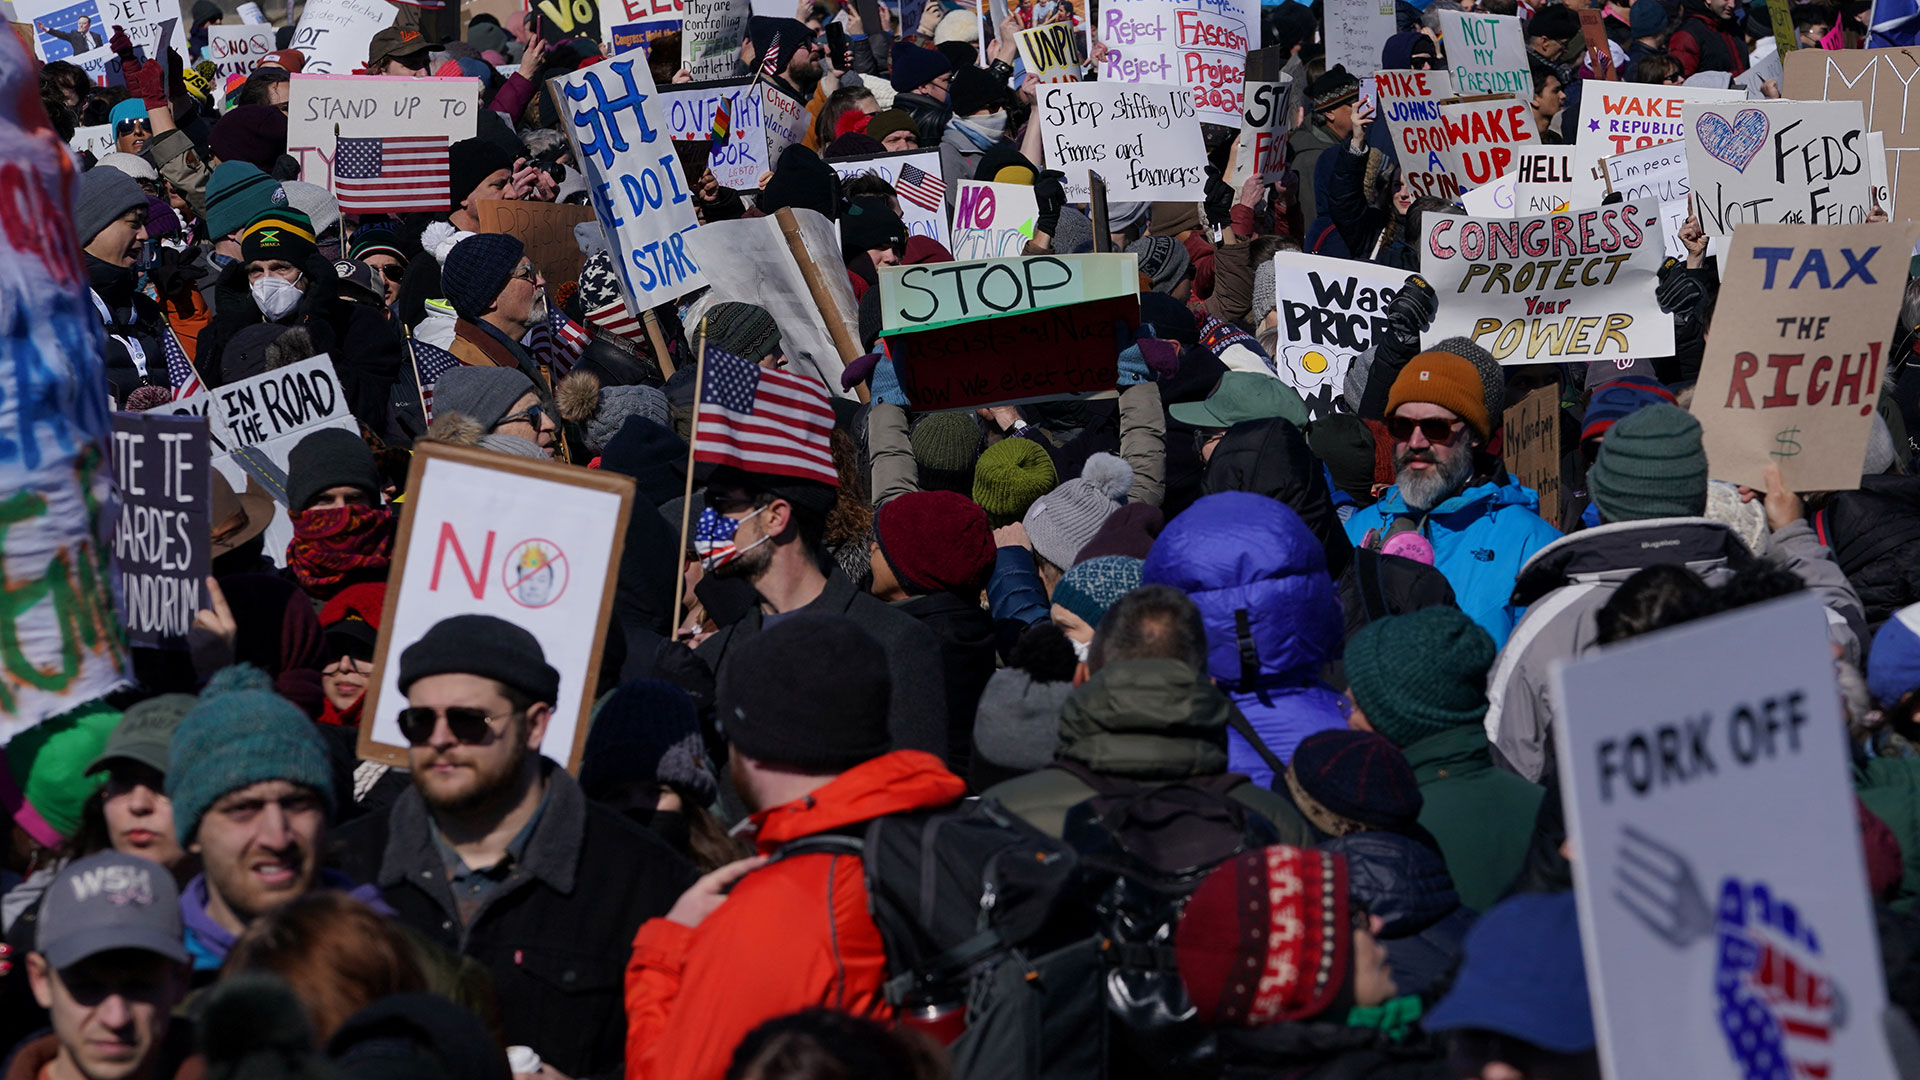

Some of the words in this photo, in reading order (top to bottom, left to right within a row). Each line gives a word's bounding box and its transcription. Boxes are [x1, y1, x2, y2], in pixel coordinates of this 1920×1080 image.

[684, 0, 712, 20] They
[714, 1, 730, 11] are
[685, 15, 741, 31] controlling
[694, 30, 719, 42] your
[1106, 9, 1167, 45] Reject
[1461, 16, 1500, 49] NOT
[228, 38, 248, 55] NO
[1473, 48, 1494, 66] MY
[710, 58, 723, 74] let
[1107, 50, 1171, 83] Reject
[1375, 71, 1433, 98] MIKE
[305, 96, 378, 121] STAND
[394, 97, 421, 119] UP
[440, 98, 467, 119] TO
[766, 87, 801, 121] Checks
[1046, 88, 1104, 129] Stop
[1111, 91, 1171, 129] stiffing
[1169, 90, 1196, 119] US
[1602, 94, 1685, 118] WAKE
[764, 113, 797, 144] alances
[1442, 105, 1532, 146] WAKE
[1609, 118, 1684, 137] REPUBLIC
[1054, 134, 1106, 167] firms
[1115, 133, 1145, 160] and
[1428, 150, 1445, 172] A
[1462, 147, 1512, 185] UP
[1126, 158, 1201, 191] farmers
[1518, 154, 1573, 183] HELL
[1609, 154, 1681, 183] Impeac
[620, 167, 664, 218] DO
[658, 154, 687, 205] I
[957, 185, 996, 229] NO
[1529, 194, 1566, 212] AND
[1695, 182, 1774, 235] NOT
[1428, 204, 1658, 262] CONGRESS-
[1457, 253, 1632, 295] PROTECT
[1753, 245, 1882, 290] TAX
[900, 256, 1072, 323] STOP
[1524, 295, 1571, 316] Your
[1471, 313, 1634, 360] POWER
[1776, 316, 1831, 341] THE
[1724, 341, 1882, 416] RICH!
[221, 386, 257, 418] IN
[260, 369, 336, 434] ROAD
[228, 413, 268, 448] THE
[158, 432, 194, 503] TE
[1596, 717, 1718, 804] FORK
[1727, 687, 1809, 768] OFF
